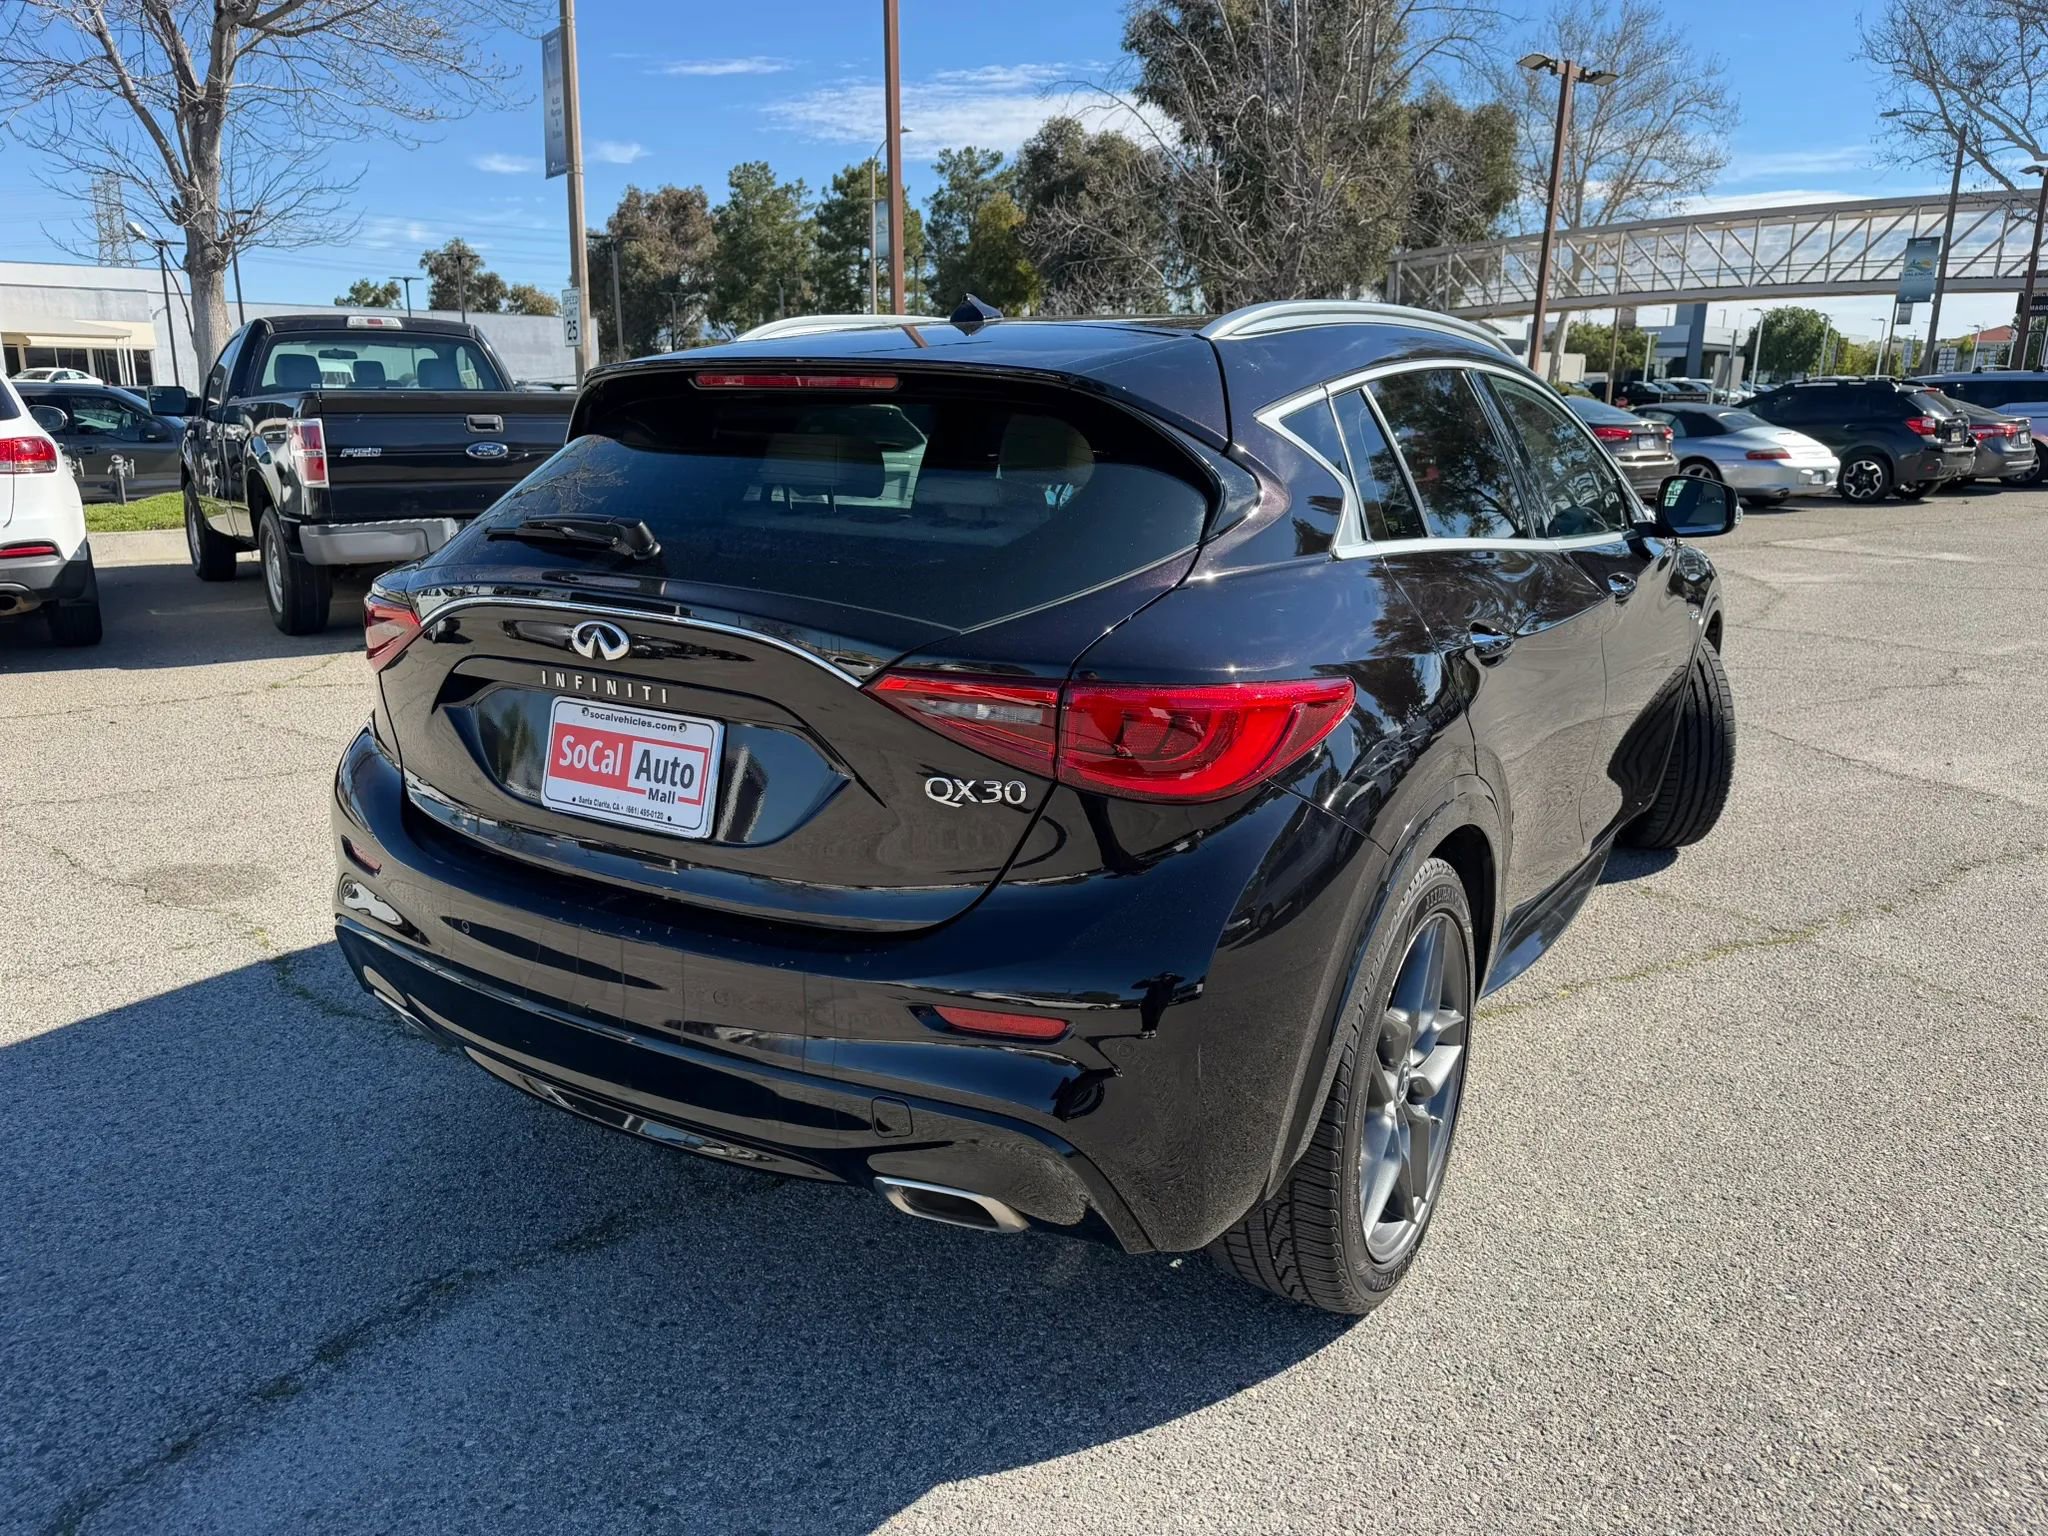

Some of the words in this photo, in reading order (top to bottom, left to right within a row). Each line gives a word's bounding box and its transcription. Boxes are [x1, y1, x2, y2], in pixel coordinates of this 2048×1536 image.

[563, 295, 578, 305] SPEED
[565, 307, 577, 317] LIMIT
[567, 320, 578, 340] 25
[541, 670, 668, 703] INFINITI
[590, 711, 677, 732] socalvehicles.com
[559, 735, 624, 776] SoCal
[634, 749, 694, 789] Auto
[648, 788, 676, 805] Mall
[925, 777, 1027, 808] QX30
[578, 796, 593, 805] Santa
[612, 802, 620, 811] CA
